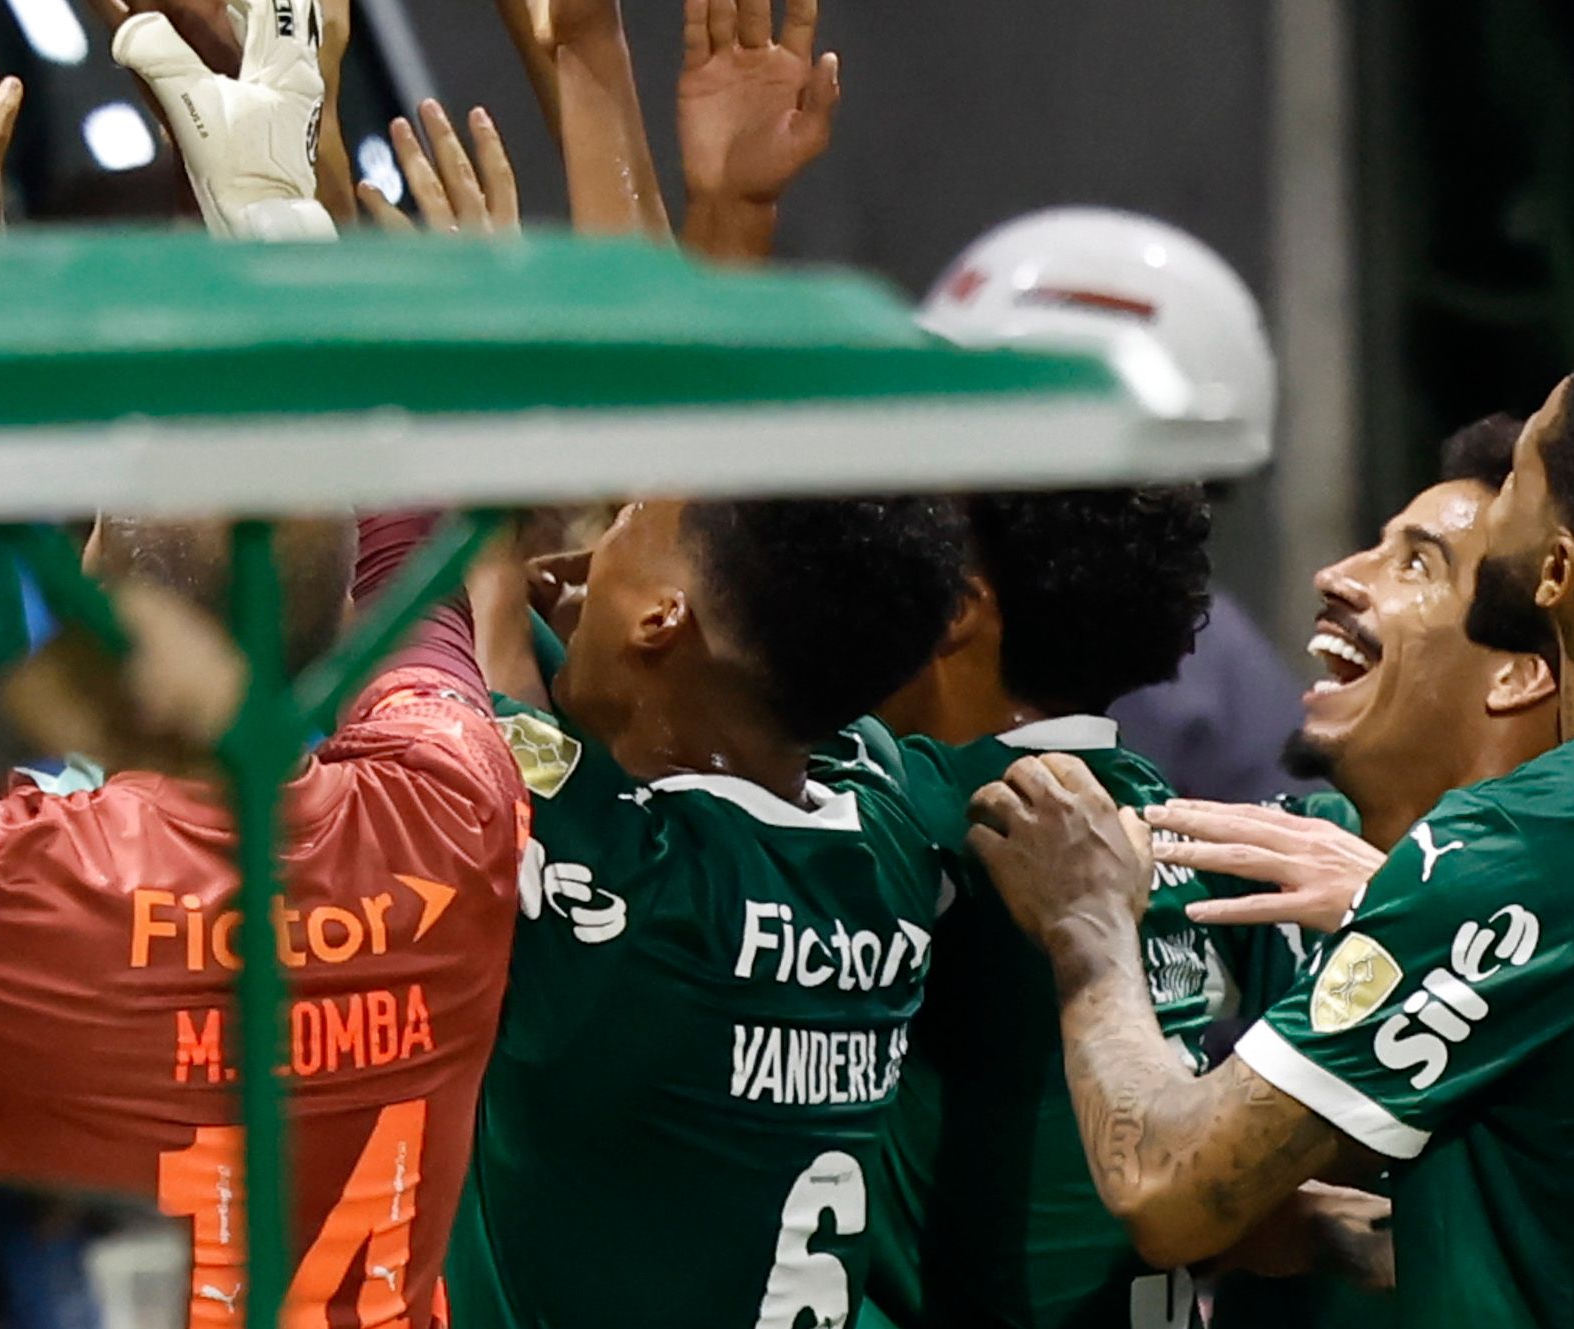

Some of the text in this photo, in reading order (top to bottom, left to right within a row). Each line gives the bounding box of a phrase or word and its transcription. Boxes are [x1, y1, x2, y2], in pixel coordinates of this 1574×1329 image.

[734, 899, 909, 991] Fictor
[271, 984, 434, 1077] OMBA
[158, 1099, 426, 1329] 14
[755, 1150, 866, 1329] 6
